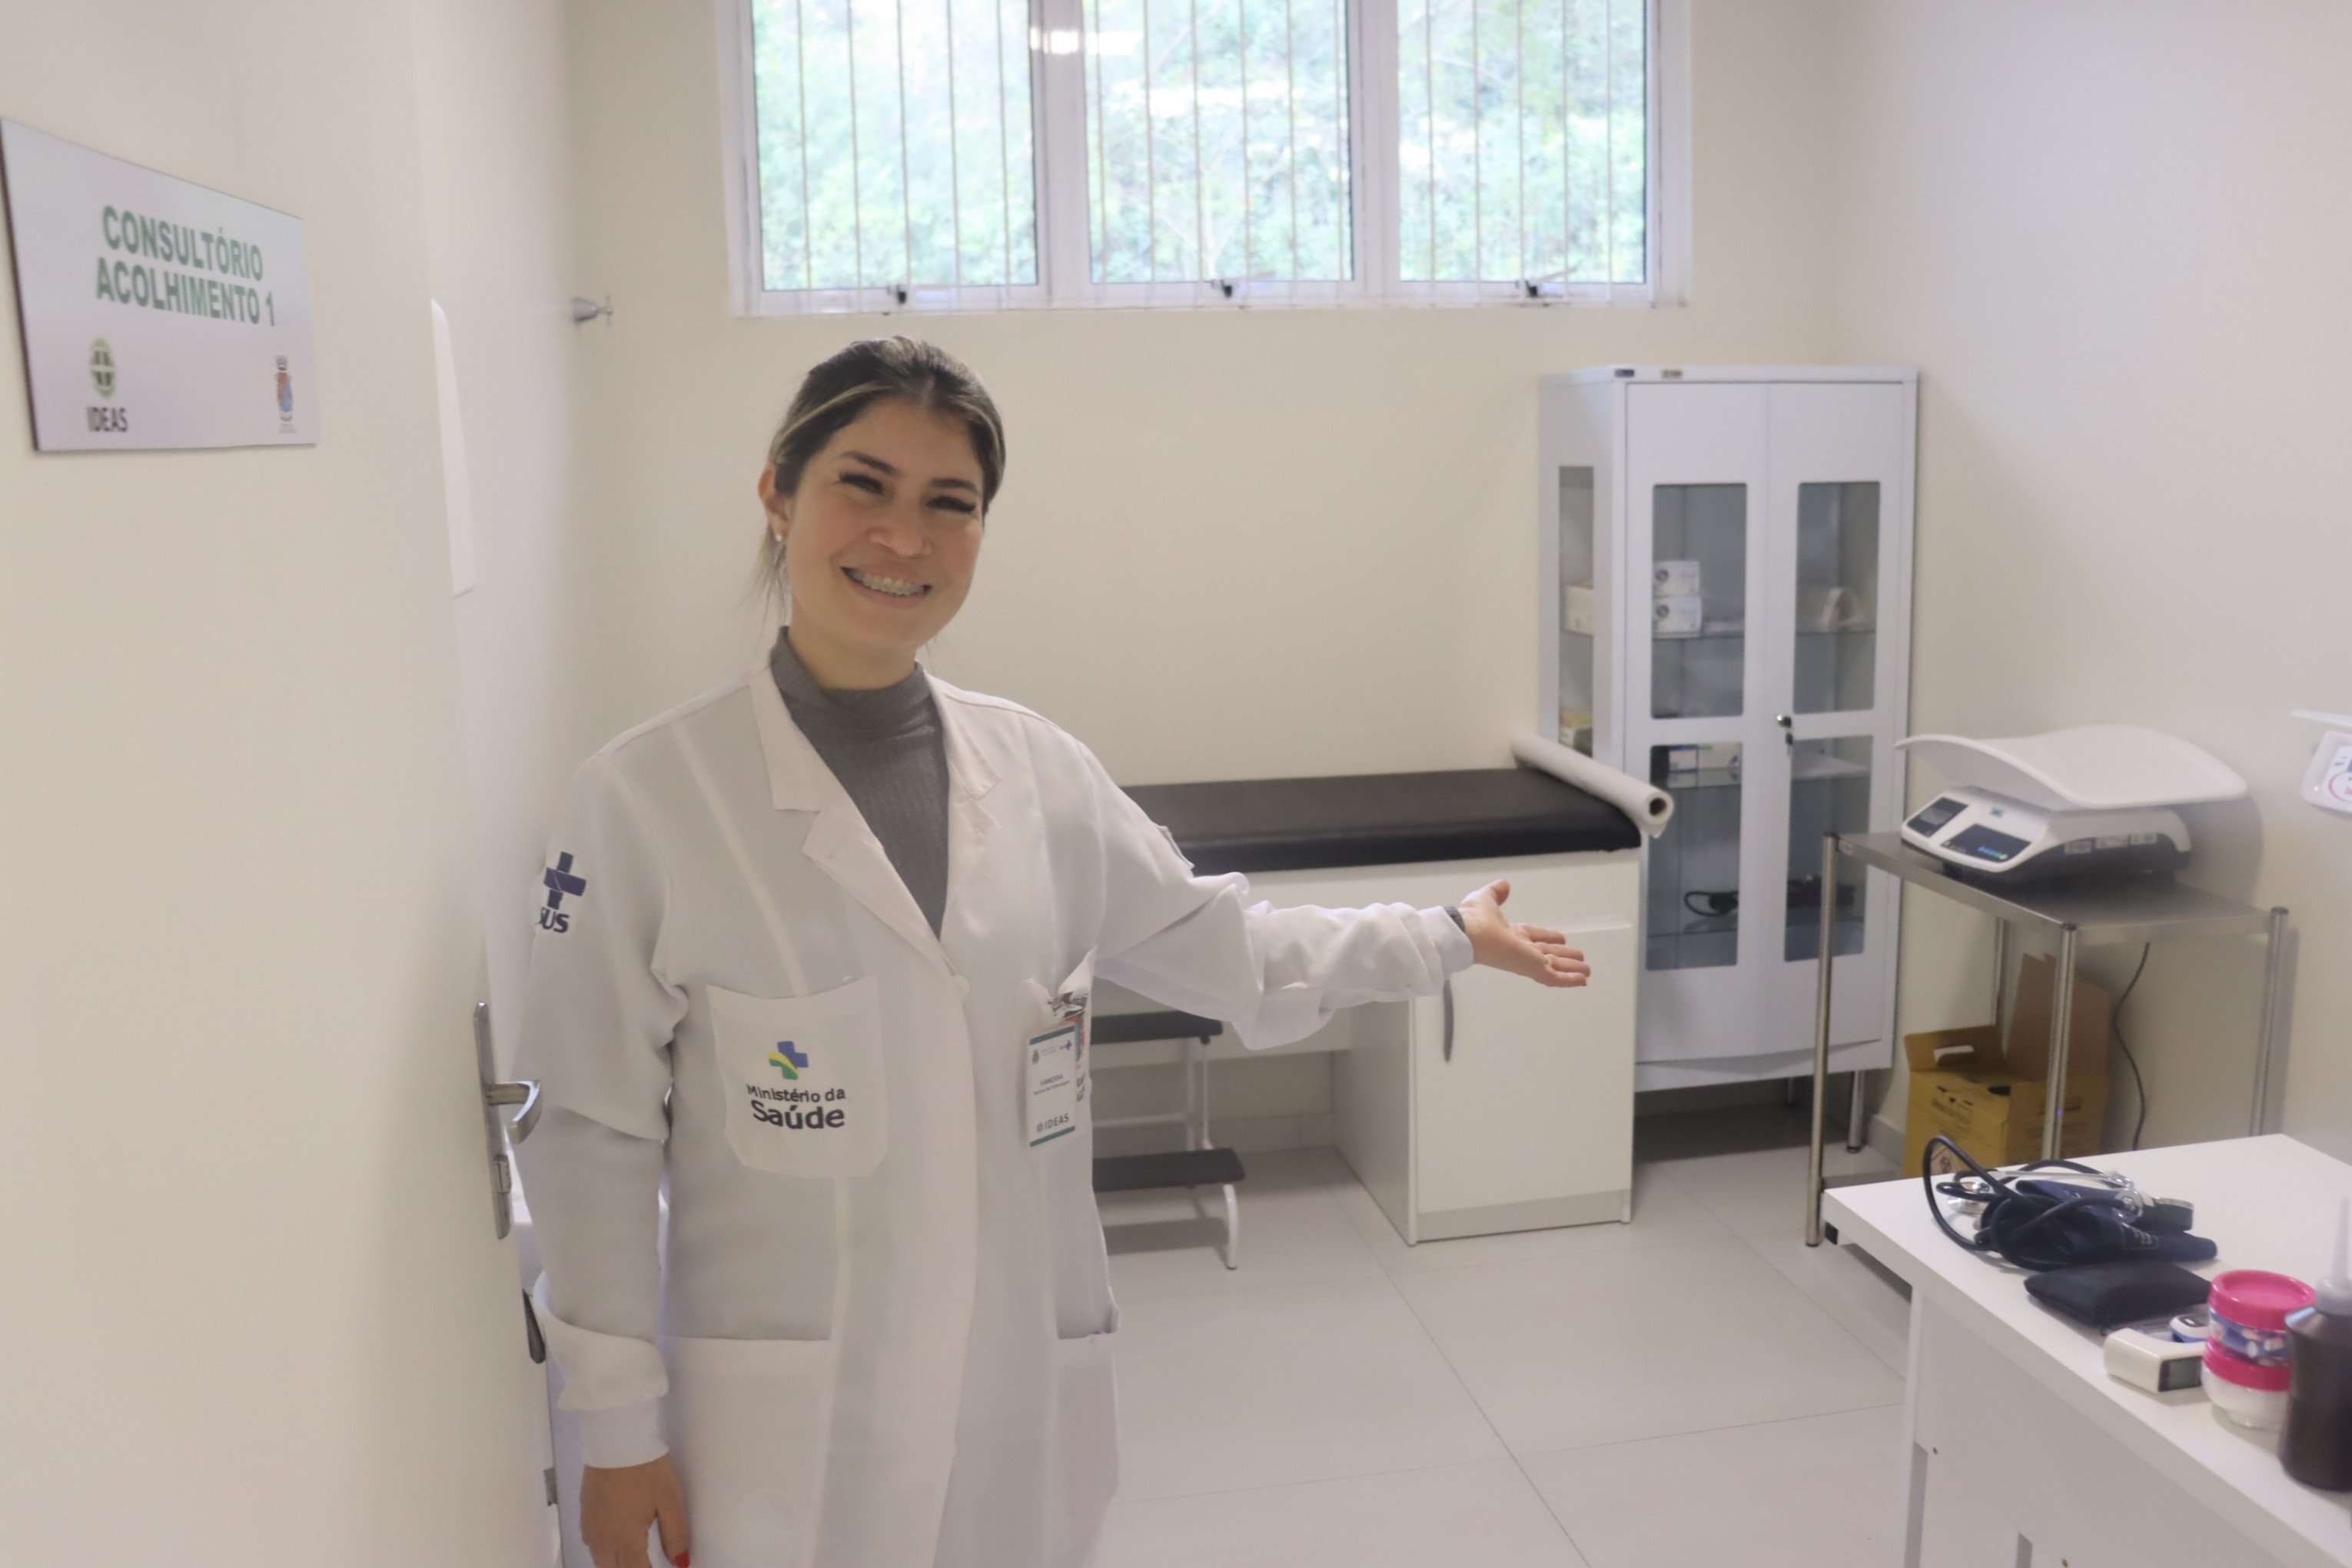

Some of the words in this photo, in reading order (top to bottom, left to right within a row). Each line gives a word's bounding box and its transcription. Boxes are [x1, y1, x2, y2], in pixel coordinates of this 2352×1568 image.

[103, 205, 263, 281] CONSULTÓRIO
[96, 257, 261, 324] ACOLHIMENTO
[265, 291, 275, 327] 1
[87, 406, 128, 432] IDEAS
[746, 1085, 820, 1102] Ministério
[825, 1088, 845, 1101] da
[751, 1100, 845, 1129] Saúde
[1045, 1113, 1069, 1130] IDEAS
